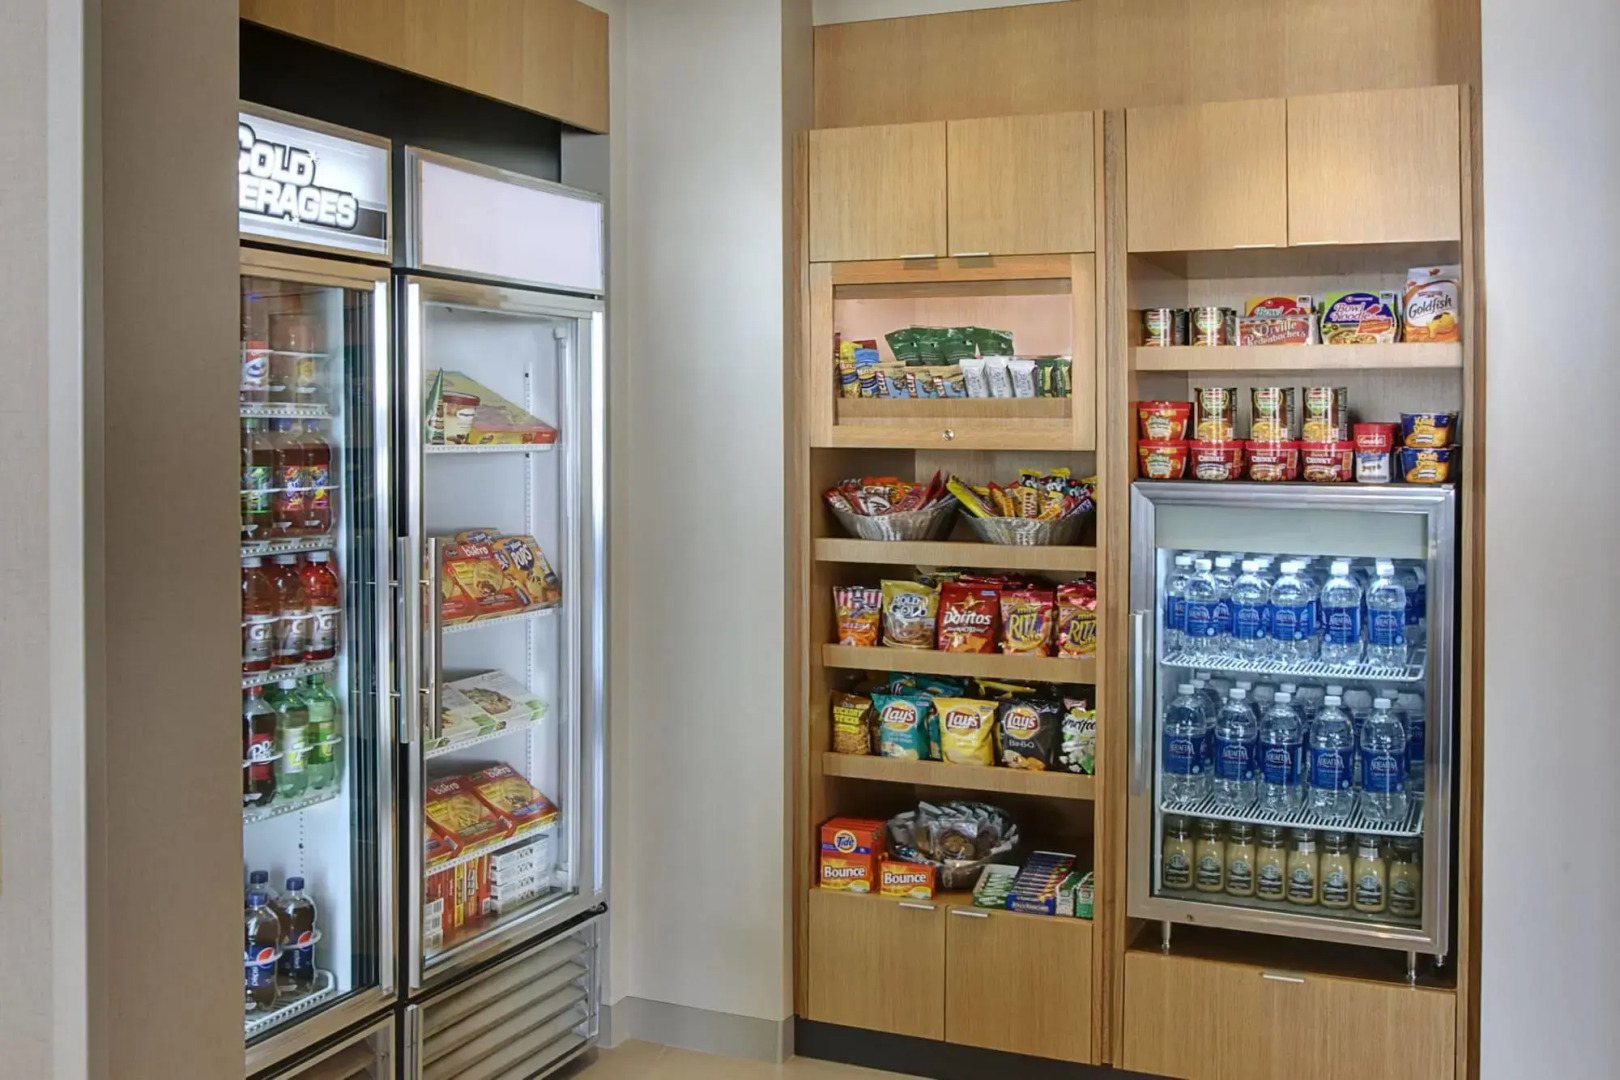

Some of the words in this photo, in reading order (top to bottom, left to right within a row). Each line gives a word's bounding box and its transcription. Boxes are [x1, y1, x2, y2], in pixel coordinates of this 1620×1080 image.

[1334, 302, 1366, 313] Bowl
[1408, 294, 1452, 318] Goldfish
[1330, 310, 1369, 321] Noodle
[944, 607, 992, 625] Doritos
[1010, 613, 1037, 638] RITZ
[884, 706, 915, 725] Lay's
[947, 712, 978, 729] Lay's
[1007, 713, 1037, 731] Lay's
[837, 836, 854, 848] Tide
[823, 866, 865, 878] Bounce
[884, 873, 926, 884] Bounce
